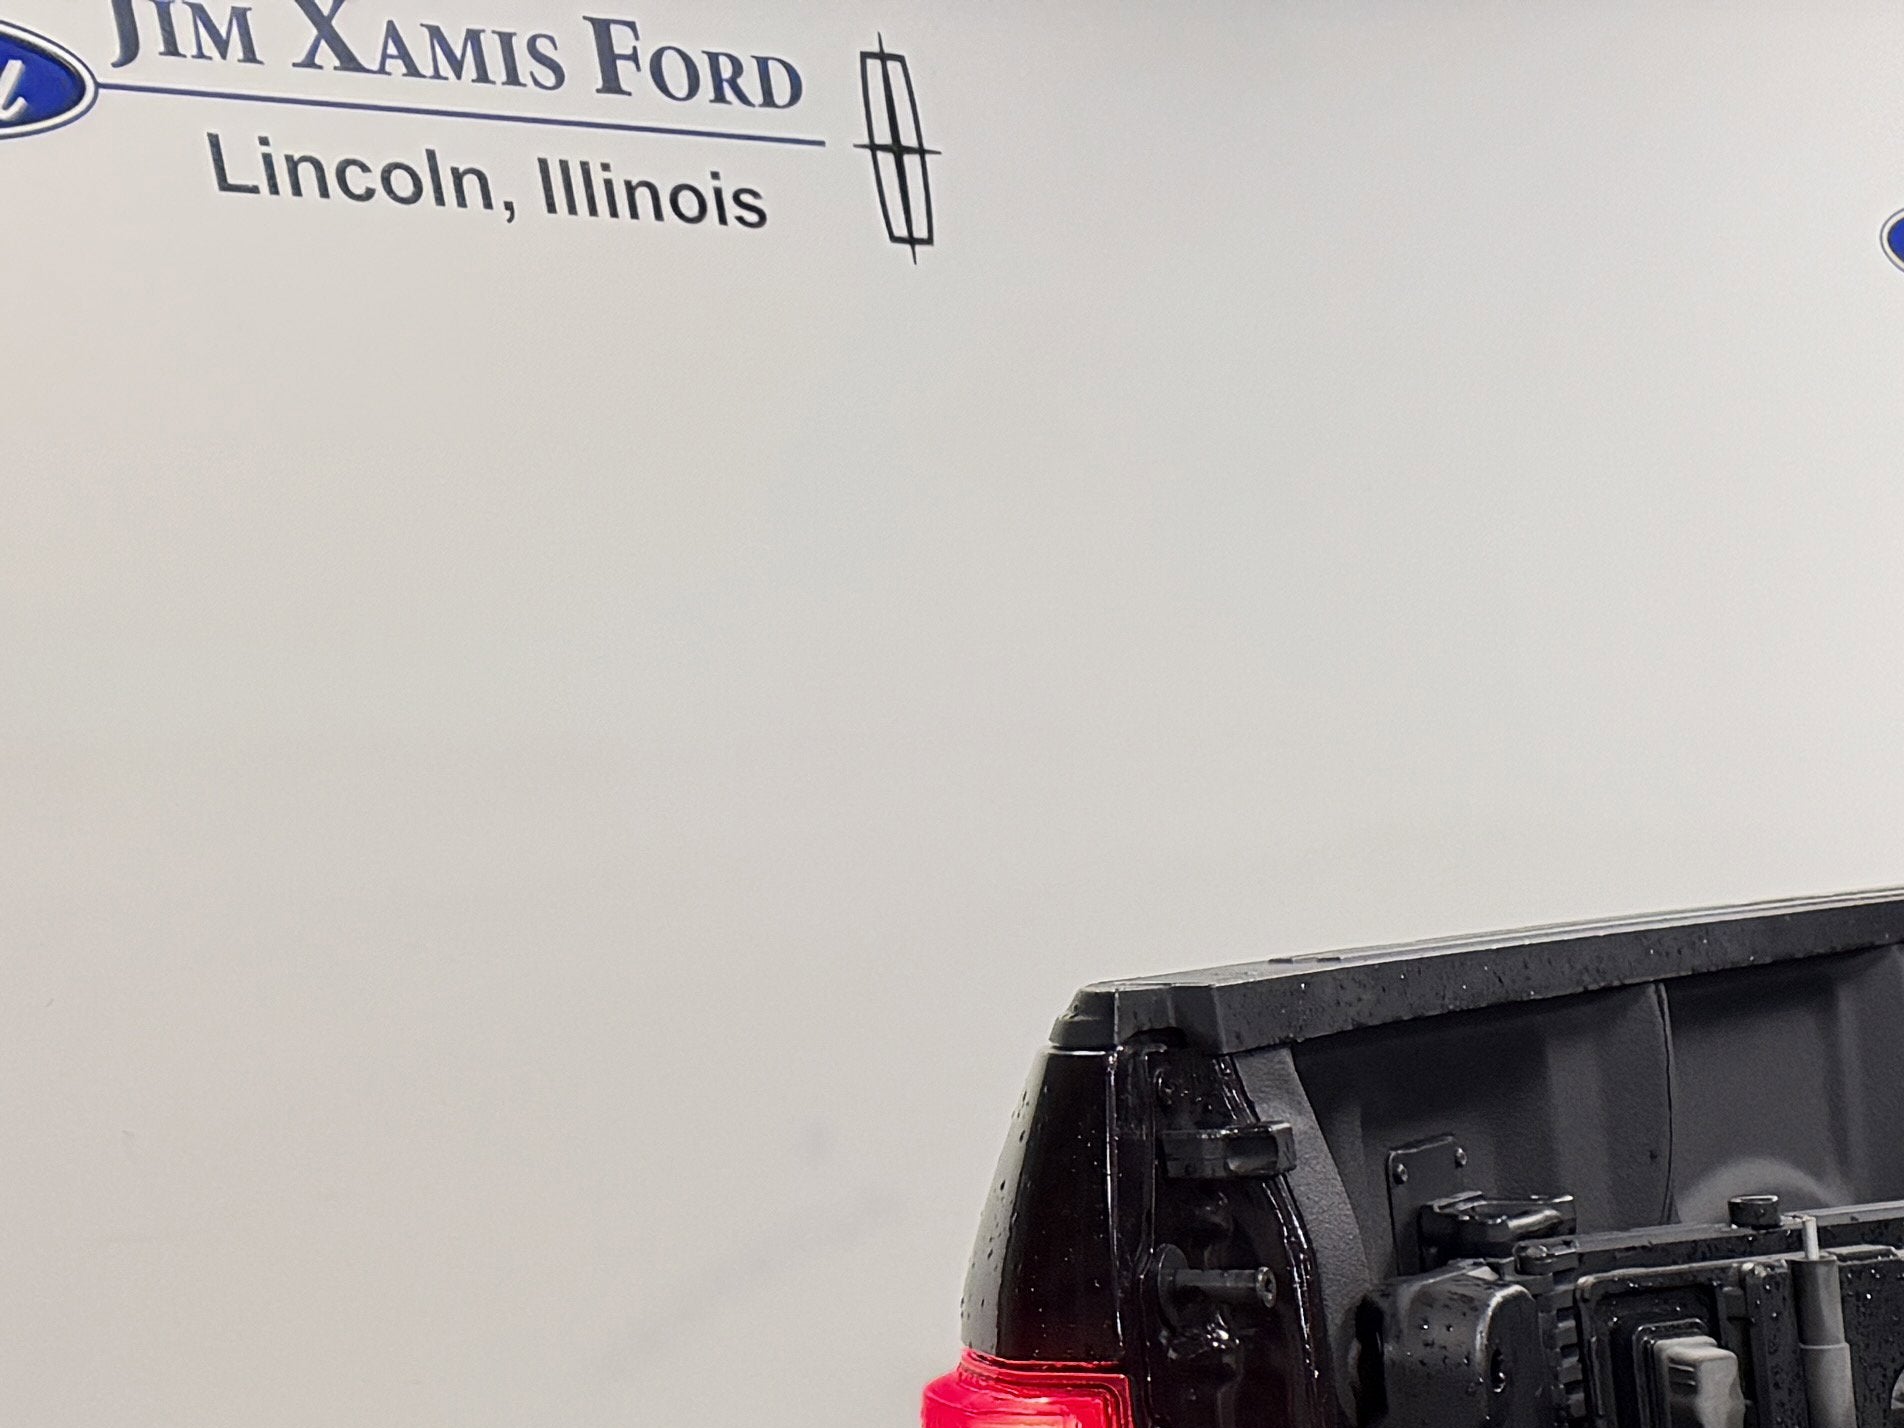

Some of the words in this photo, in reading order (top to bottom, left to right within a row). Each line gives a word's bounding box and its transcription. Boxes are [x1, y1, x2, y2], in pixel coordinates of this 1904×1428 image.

[111, 0, 264, 68] JIM
[292, 0, 565, 90] XAMIS
[582, 16, 802, 109] FORD
[207, 132, 515, 223] Lincoln,
[537, 157, 767, 229] Illinois
